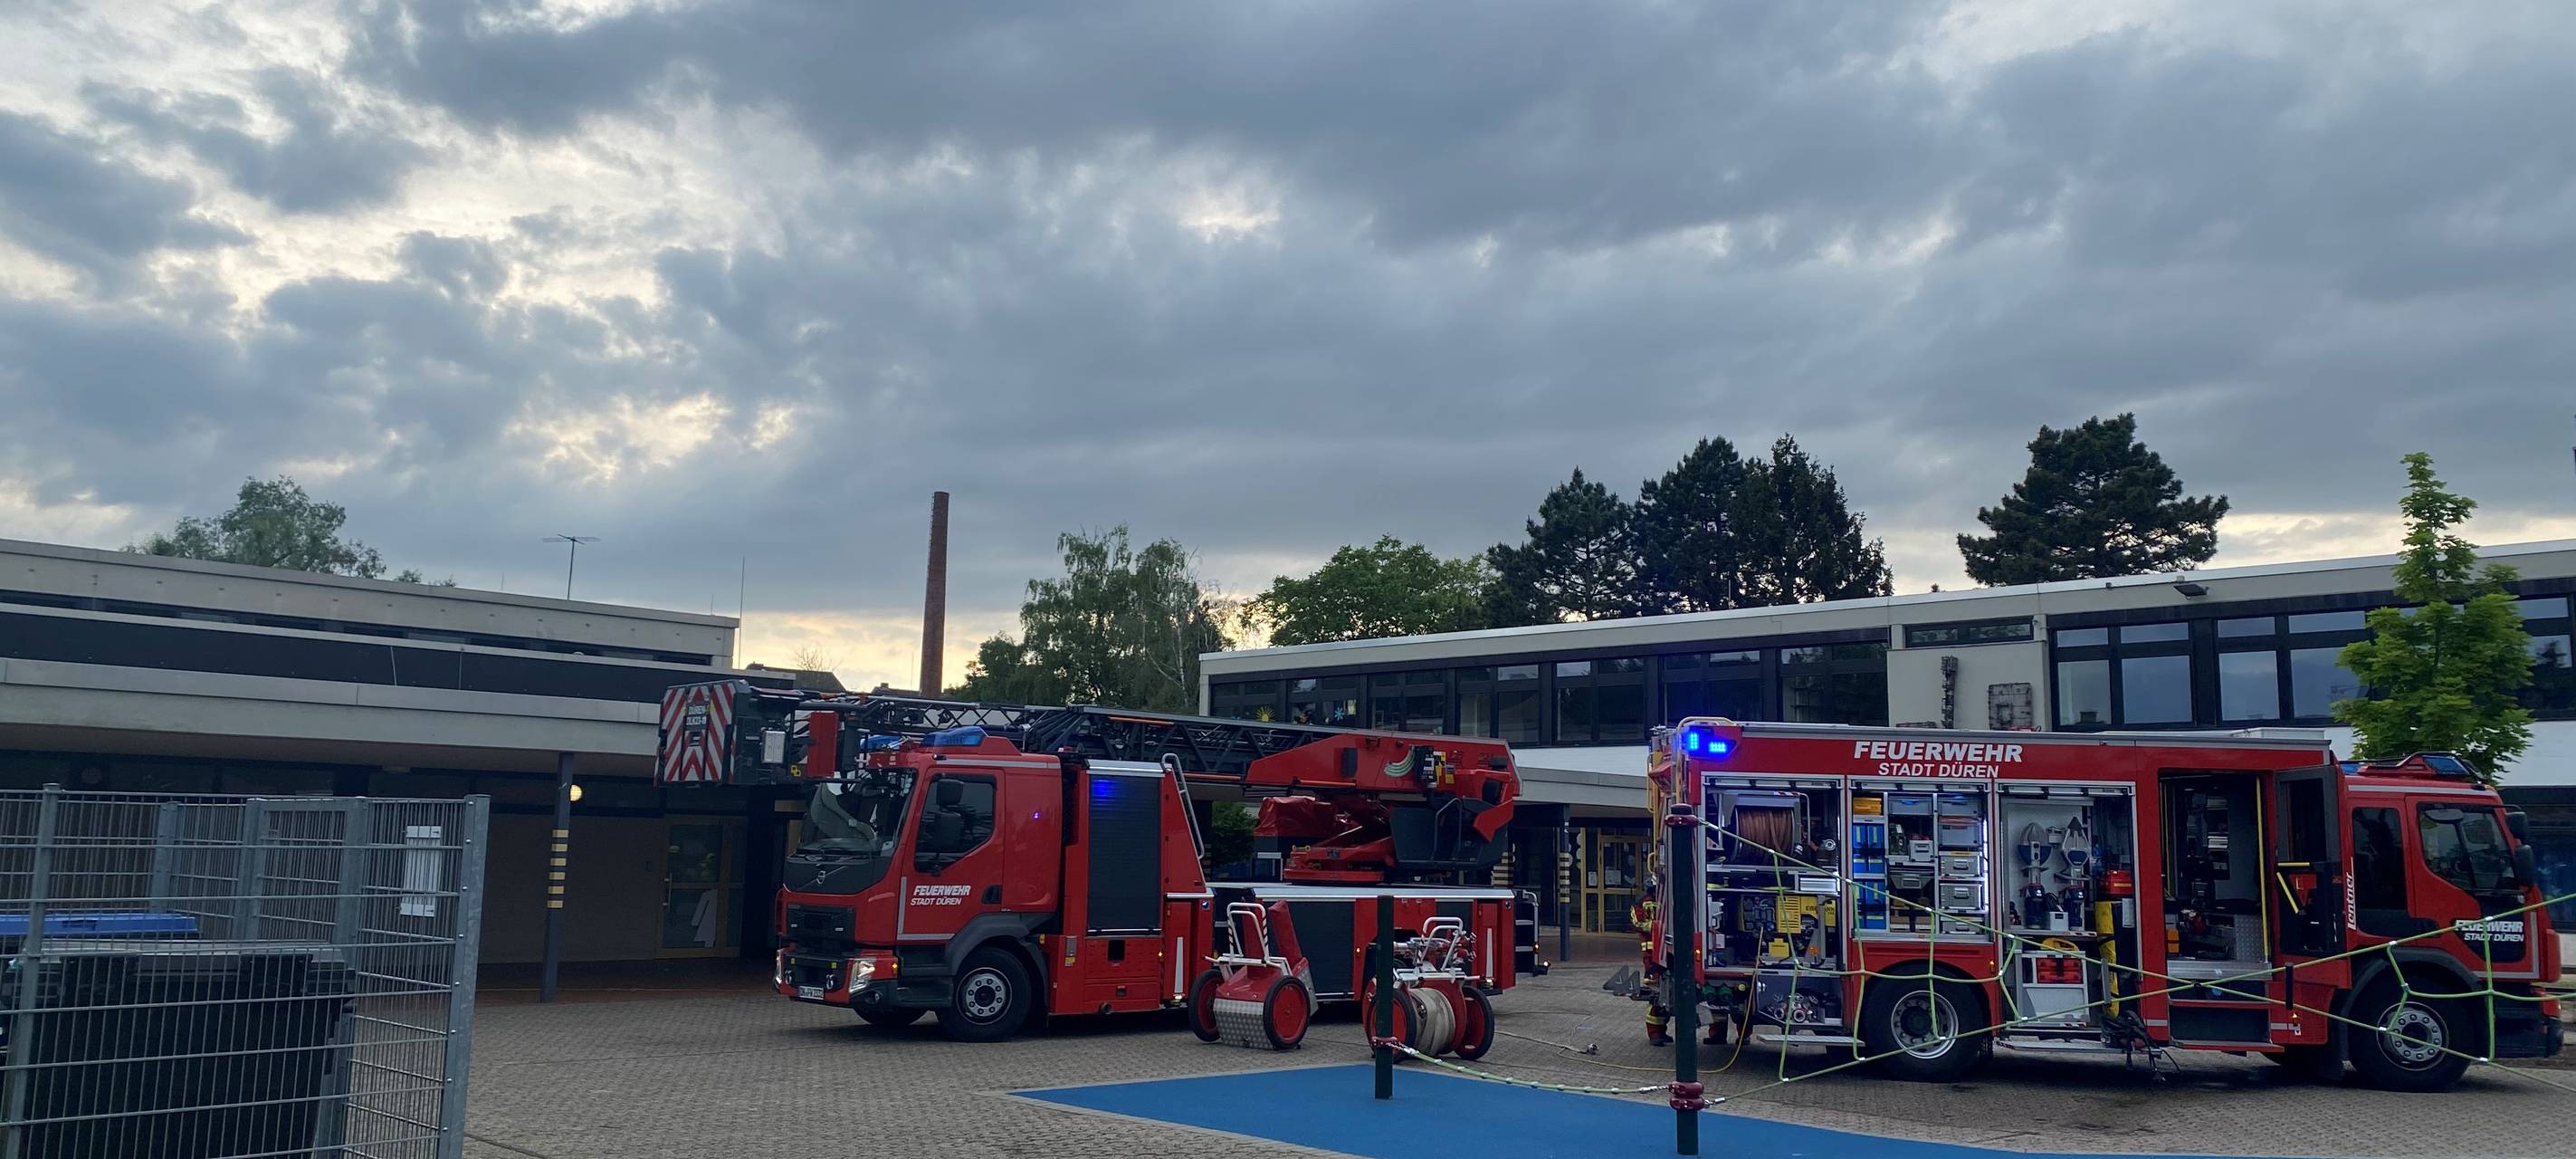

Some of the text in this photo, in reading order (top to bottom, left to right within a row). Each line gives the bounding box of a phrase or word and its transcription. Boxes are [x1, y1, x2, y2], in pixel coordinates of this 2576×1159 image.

[1854, 741, 2023, 762] FEUERWEHR
[1878, 761, 1999, 778] STADT DÜREN
[913, 885, 971, 896] FEUERWEHR
[911, 896, 962, 905] STADT DÜREN
[2494, 932, 2524, 942] DÜREN
